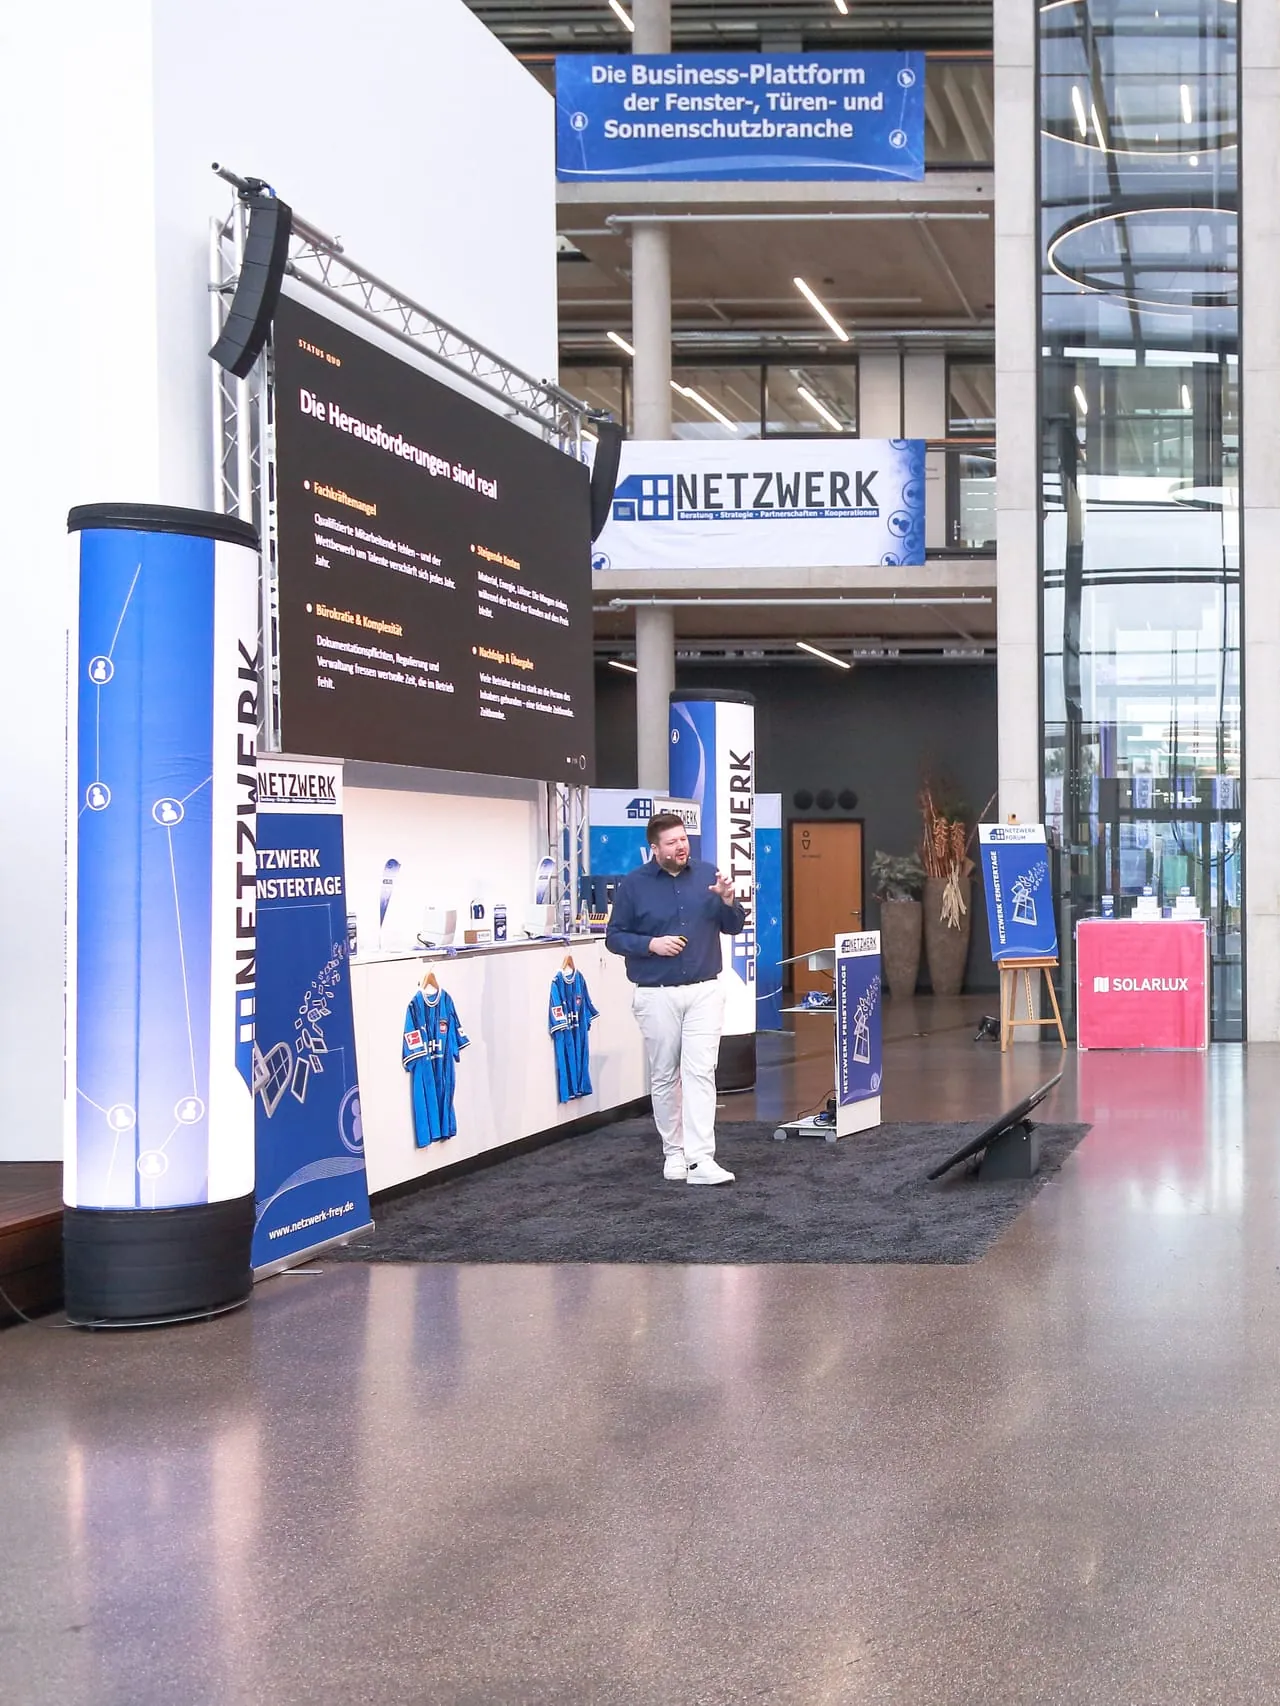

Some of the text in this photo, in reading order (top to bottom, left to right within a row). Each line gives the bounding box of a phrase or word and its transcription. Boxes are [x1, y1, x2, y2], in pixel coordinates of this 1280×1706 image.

[591, 63, 866, 85] Die Business-Plattform
[623, 91, 884, 114] der Fenster-, Türen- und
[604, 118, 854, 139] Sonnenschutzbranche
[298, 338, 341, 367] STATUS QUO
[300, 388, 498, 500] Die Herausforderungen sind real
[314, 481, 377, 516] Fachkräftemangel
[676, 470, 879, 510] NETZWERK
[680, 508, 878, 520] Beratung Strategie Partnerschaften Kooperationen
[314, 533, 356, 557] Wettbewerb
[355, 549, 367, 561] um
[316, 603, 404, 636] Bürokratie & Komplexität
[316, 655, 355, 675] Verwaltung
[316, 675, 336, 690] fehlt.
[258, 772, 336, 798] NETZWERK
[256, 849, 321, 869] TZWERK
[990, 850, 1007, 944] NETZWERK FENSTERTAGE
[850, 937, 877, 950] NETZWERK
[1113, 978, 1189, 991] SOLARLUX
[840, 1037, 848, 1094] NETZWERK
[268, 1201, 354, 1240] www.netzwerk-frey.de
